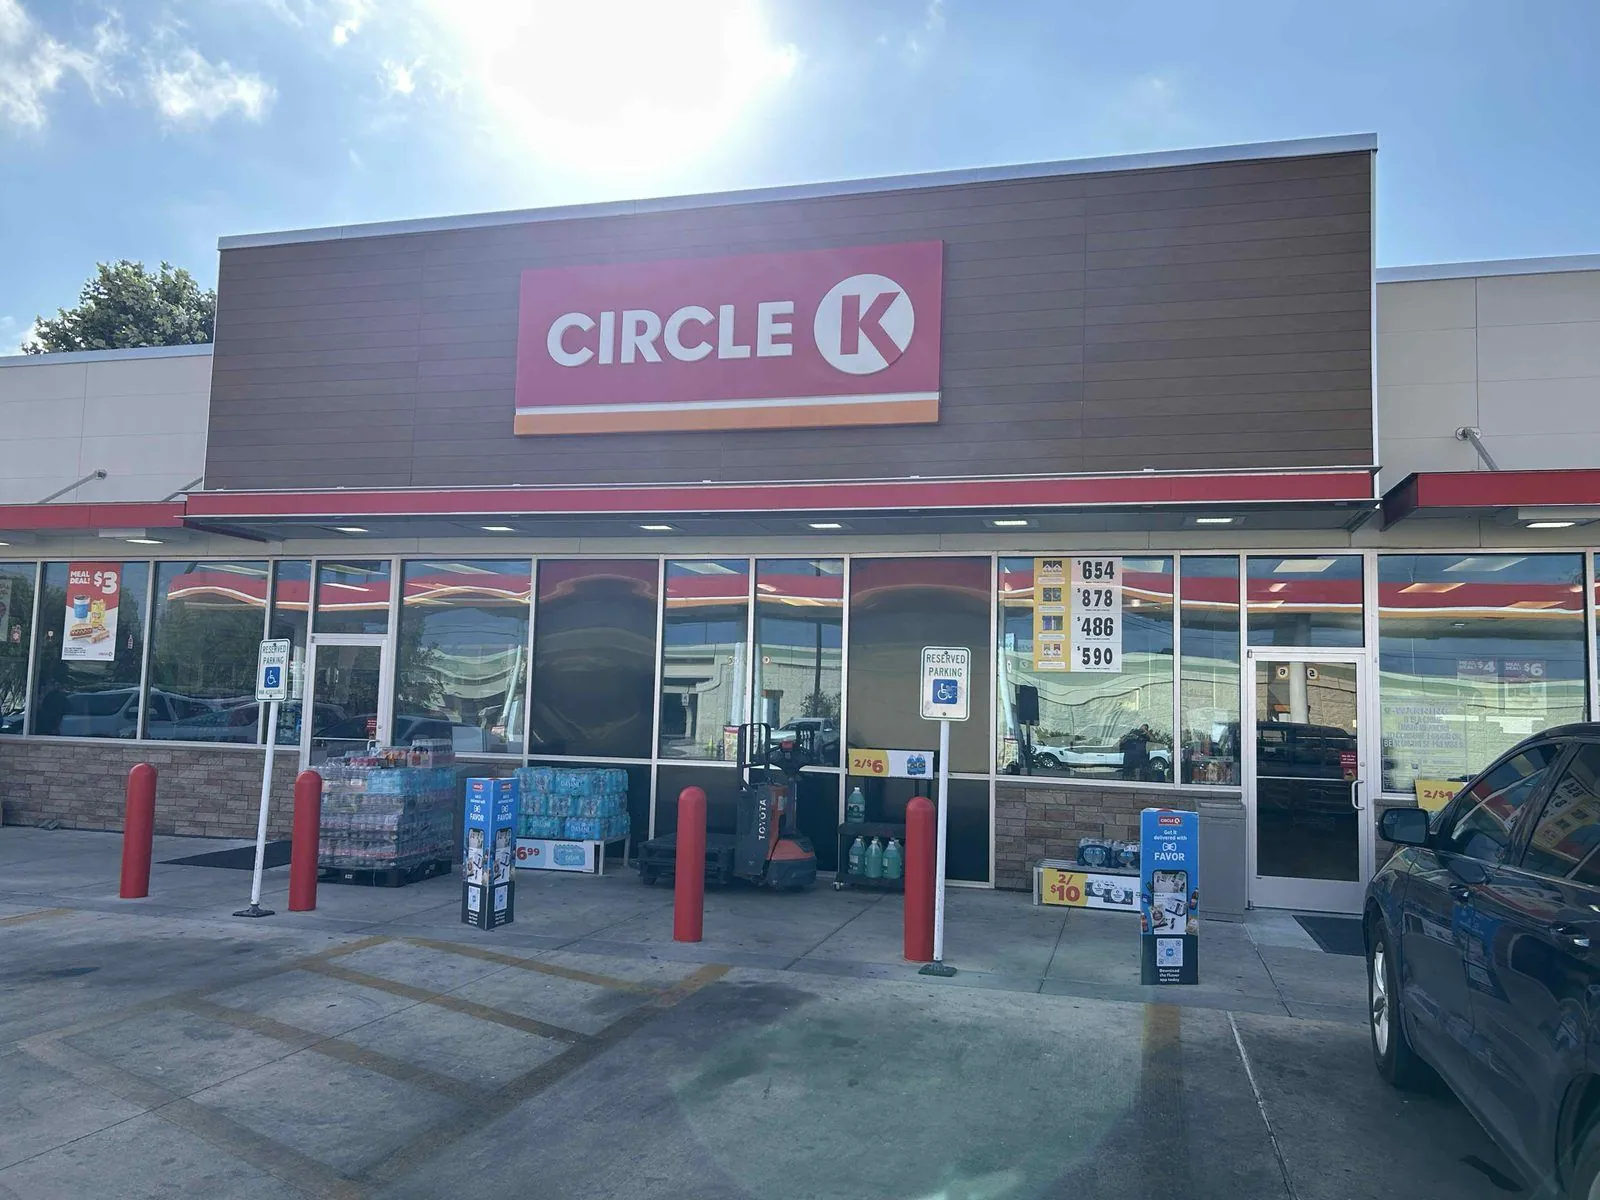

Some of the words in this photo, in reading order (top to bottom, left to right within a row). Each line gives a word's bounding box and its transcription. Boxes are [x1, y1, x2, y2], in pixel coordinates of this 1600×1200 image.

[547, 300, 795, 367] CIRCLE
[70, 570, 90, 578] MEAL
[69, 577, 91, 585] DEAL!
[93, 571, 118, 594] $3
[262, 644, 287, 654] RESERVED
[263, 656, 284, 665] PARKING
[926, 653, 966, 664] RESERVED
[928, 667, 963, 677] PARKING
[1477, 660, 1496, 673] $4
[1524, 663, 1544, 676] $6
[854, 759, 884, 774] 2/$6
[758, 799, 767, 841] TOYOTA
[1154, 852, 1185, 861] FAVOR
[1058, 874, 1073, 886] 2/
[1050, 885, 1081, 902] $10
